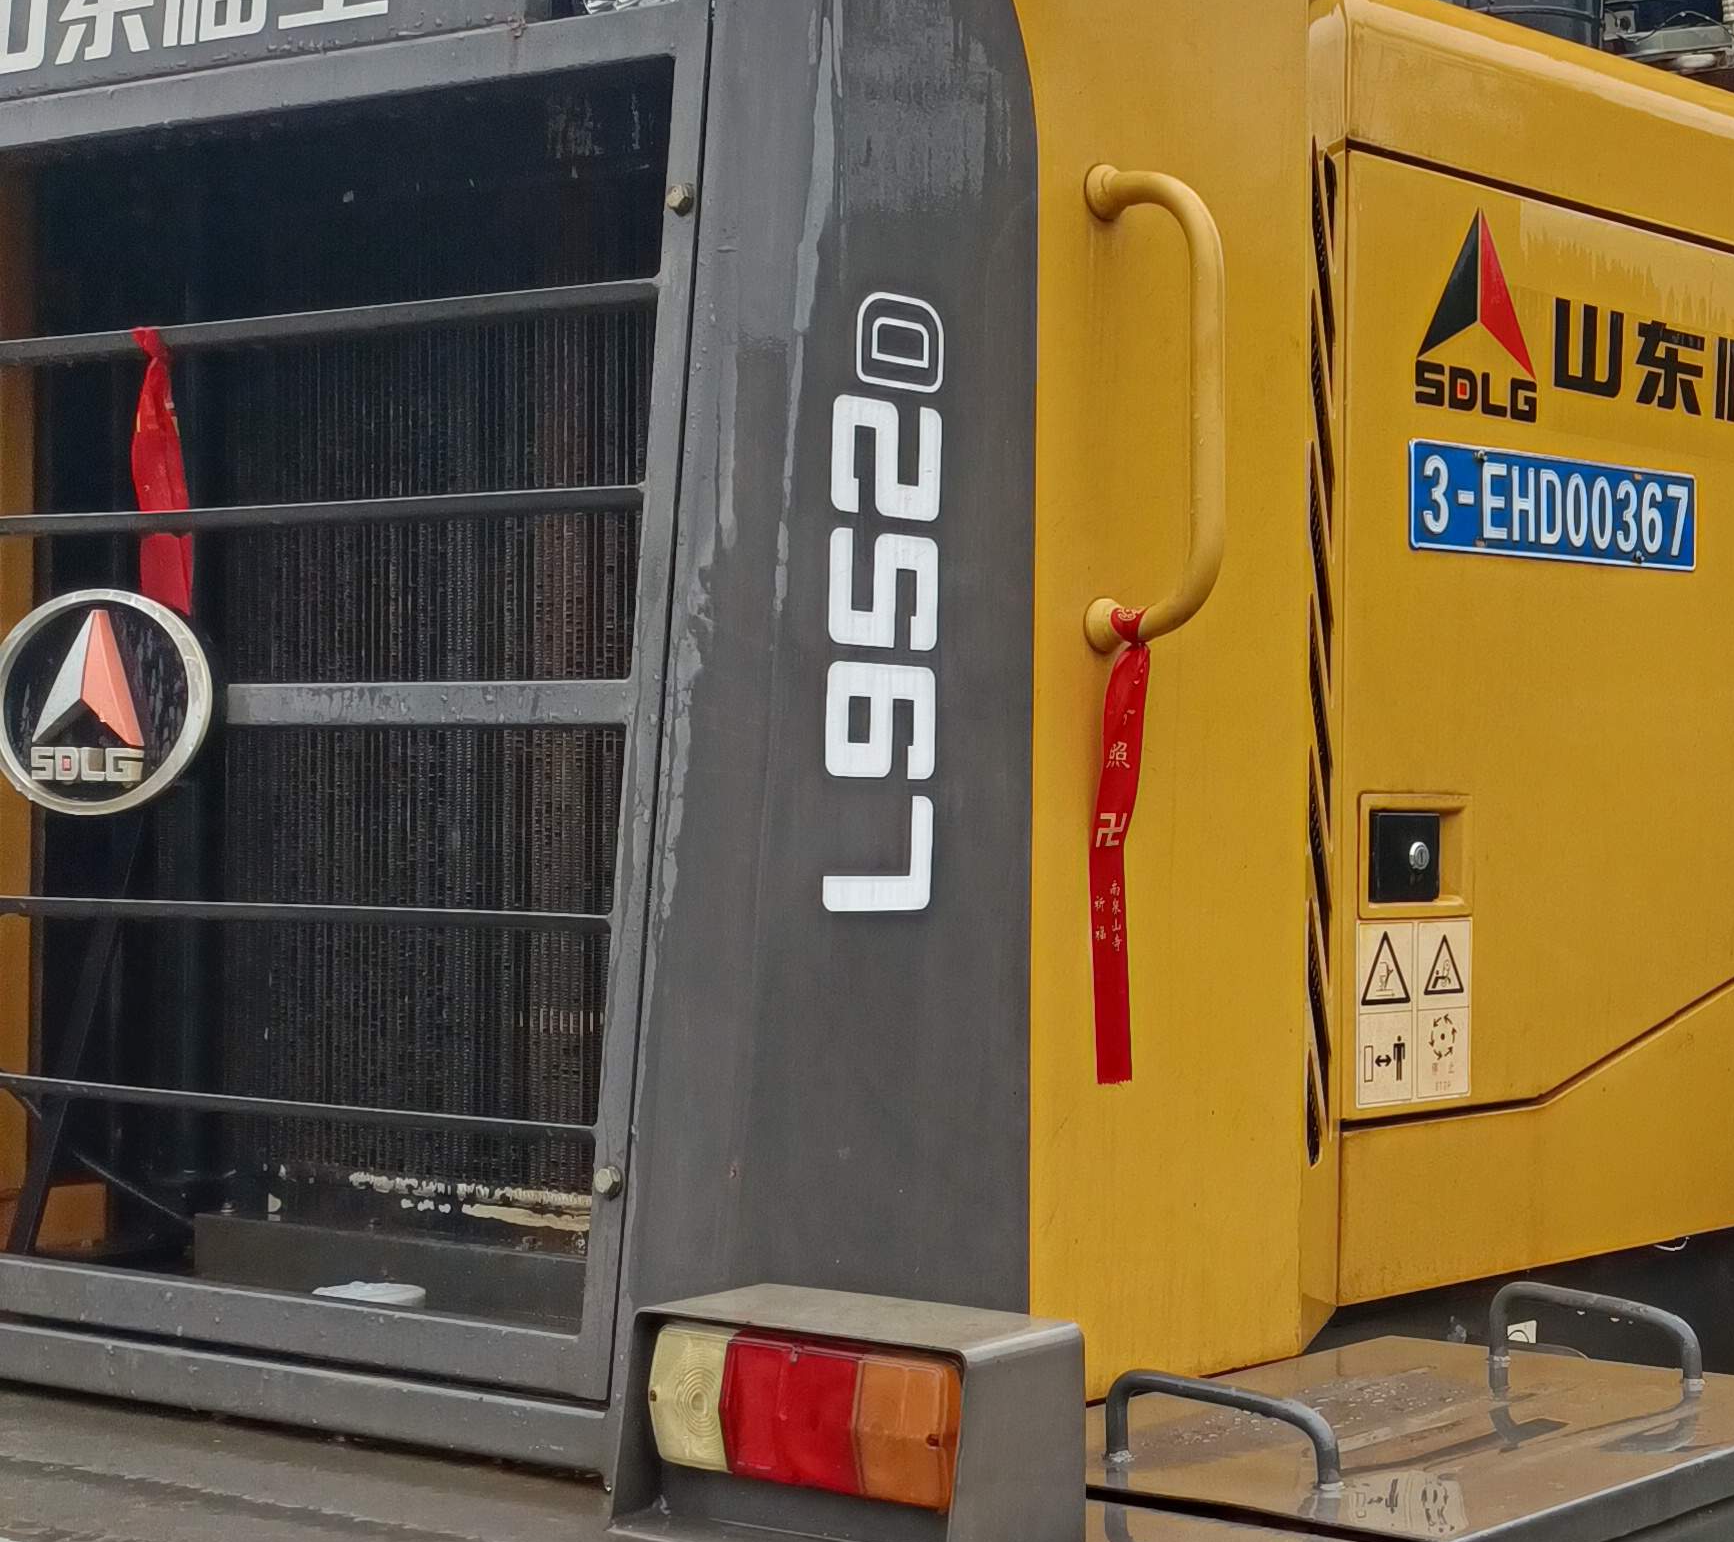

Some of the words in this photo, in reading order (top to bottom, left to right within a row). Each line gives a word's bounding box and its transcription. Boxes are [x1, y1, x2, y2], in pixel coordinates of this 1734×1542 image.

[1415, 359, 1538, 424] SDLG
[1423, 454, 1689, 557] 3-EHD00367
[31, 746, 145, 782] SDLG
